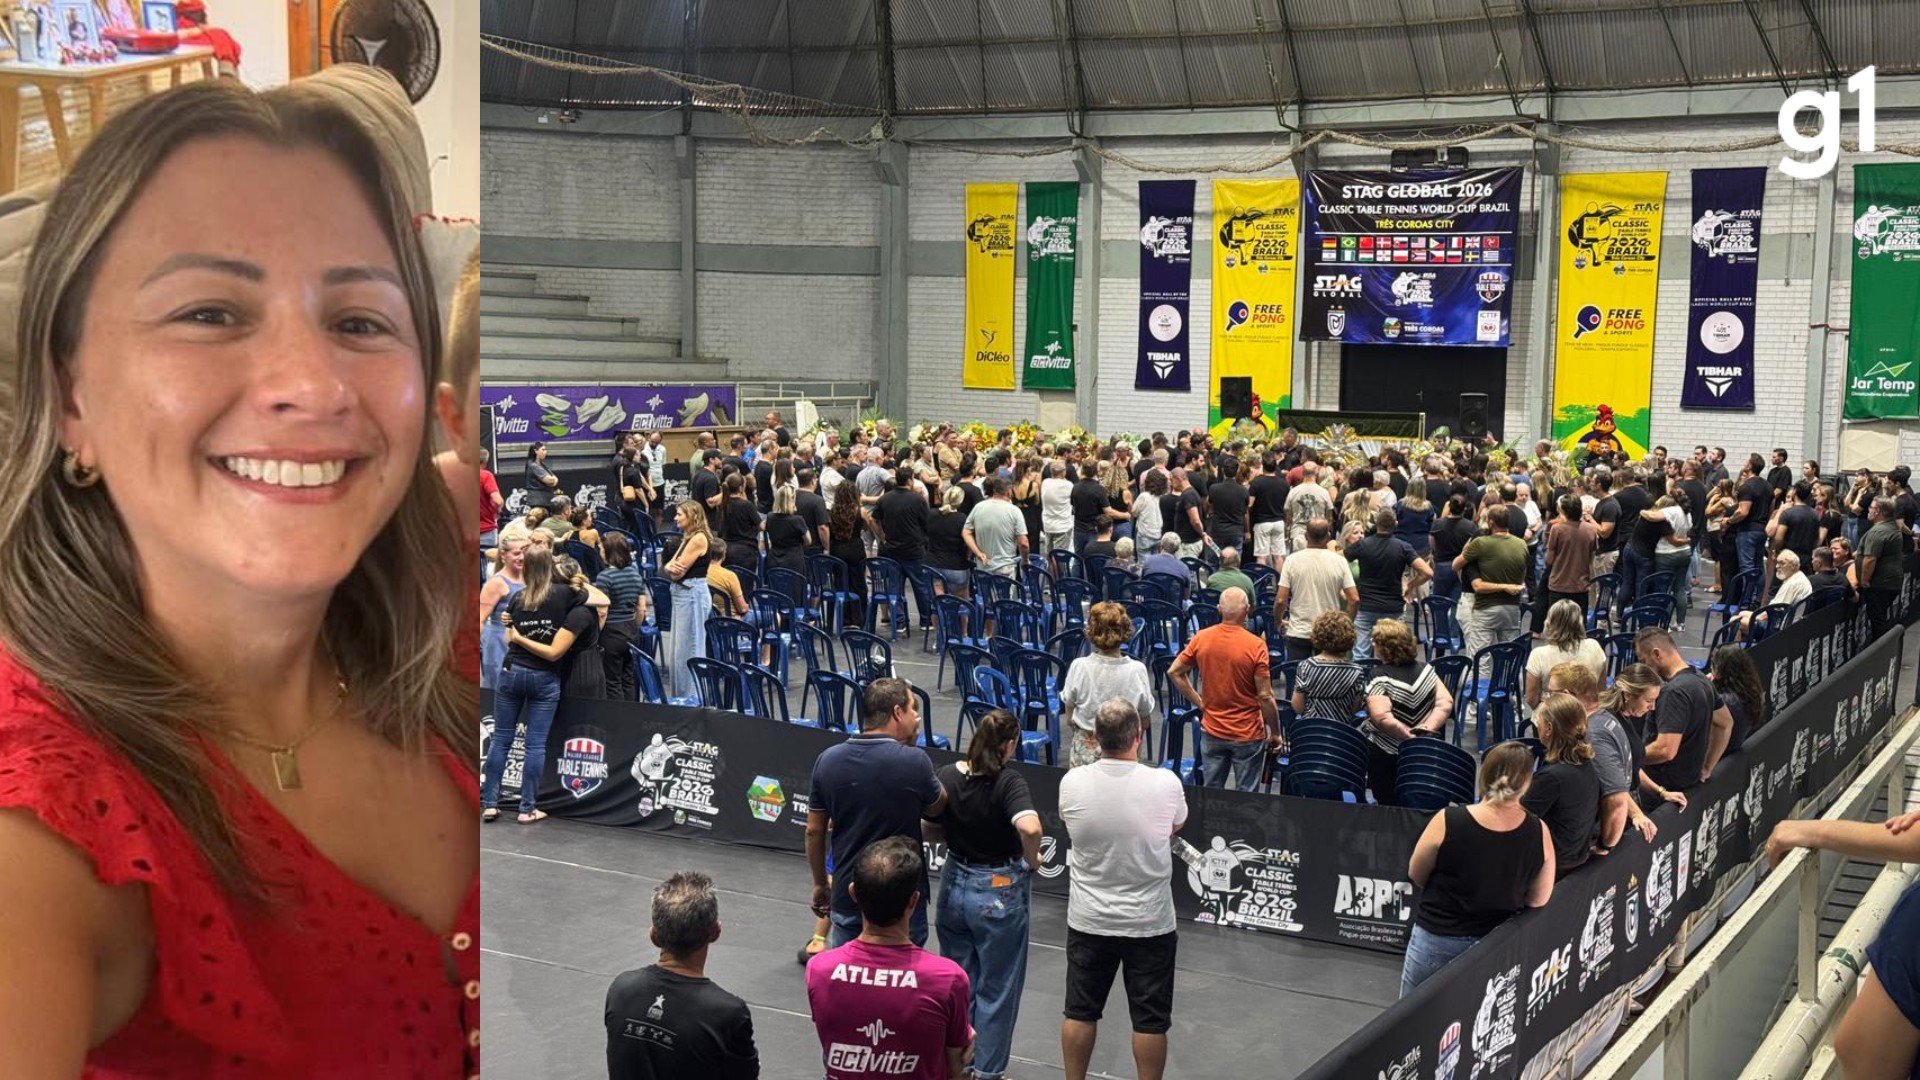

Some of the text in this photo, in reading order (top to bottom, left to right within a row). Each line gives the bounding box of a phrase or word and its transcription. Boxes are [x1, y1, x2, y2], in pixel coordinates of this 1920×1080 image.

[1342, 183, 1492, 198] STAG GLOBAL 2026
[1318, 203, 1510, 214] CLASSIC TABLE TENNIS WORLD CUP BRAZIL
[1634, 203, 1660, 211] STAG
[1375, 218, 1454, 229] TRÊS COROAS CITY
[1610, 238, 1650, 246] 2026
[1313, 274, 1362, 290] STAG
[1254, 304, 1283, 314] FREE
[1608, 309, 1642, 319] FREE
[1252, 314, 1285, 324] PONG
[1605, 319, 1645, 330] PONG
[976, 352, 1010, 362] DiCléo
[1147, 352, 1181, 361] TIBHAR
[1696, 366, 1742, 376] TIBHAR
[1851, 376, 1915, 393] Jar Temp
[693, 742, 718, 754] STAG
[557, 758, 608, 778] TABLE TENNIS
[676, 758, 713, 772] CLASSIC
[672, 777, 714, 796] 2026
[669, 789, 711, 806] BRAZIL
[1267, 848, 1299, 862] STAG
[1245, 867, 1294, 882] CLASSIC
[1252, 879, 1297, 890] TABLE TENNIS
[1240, 890, 1297, 911] 2026
[1334, 874, 1413, 920] ABPC
[1238, 902, 1294, 922] BRAZIL
[830, 963, 918, 988] ATLETA
[1528, 943, 1572, 1004] STAG
